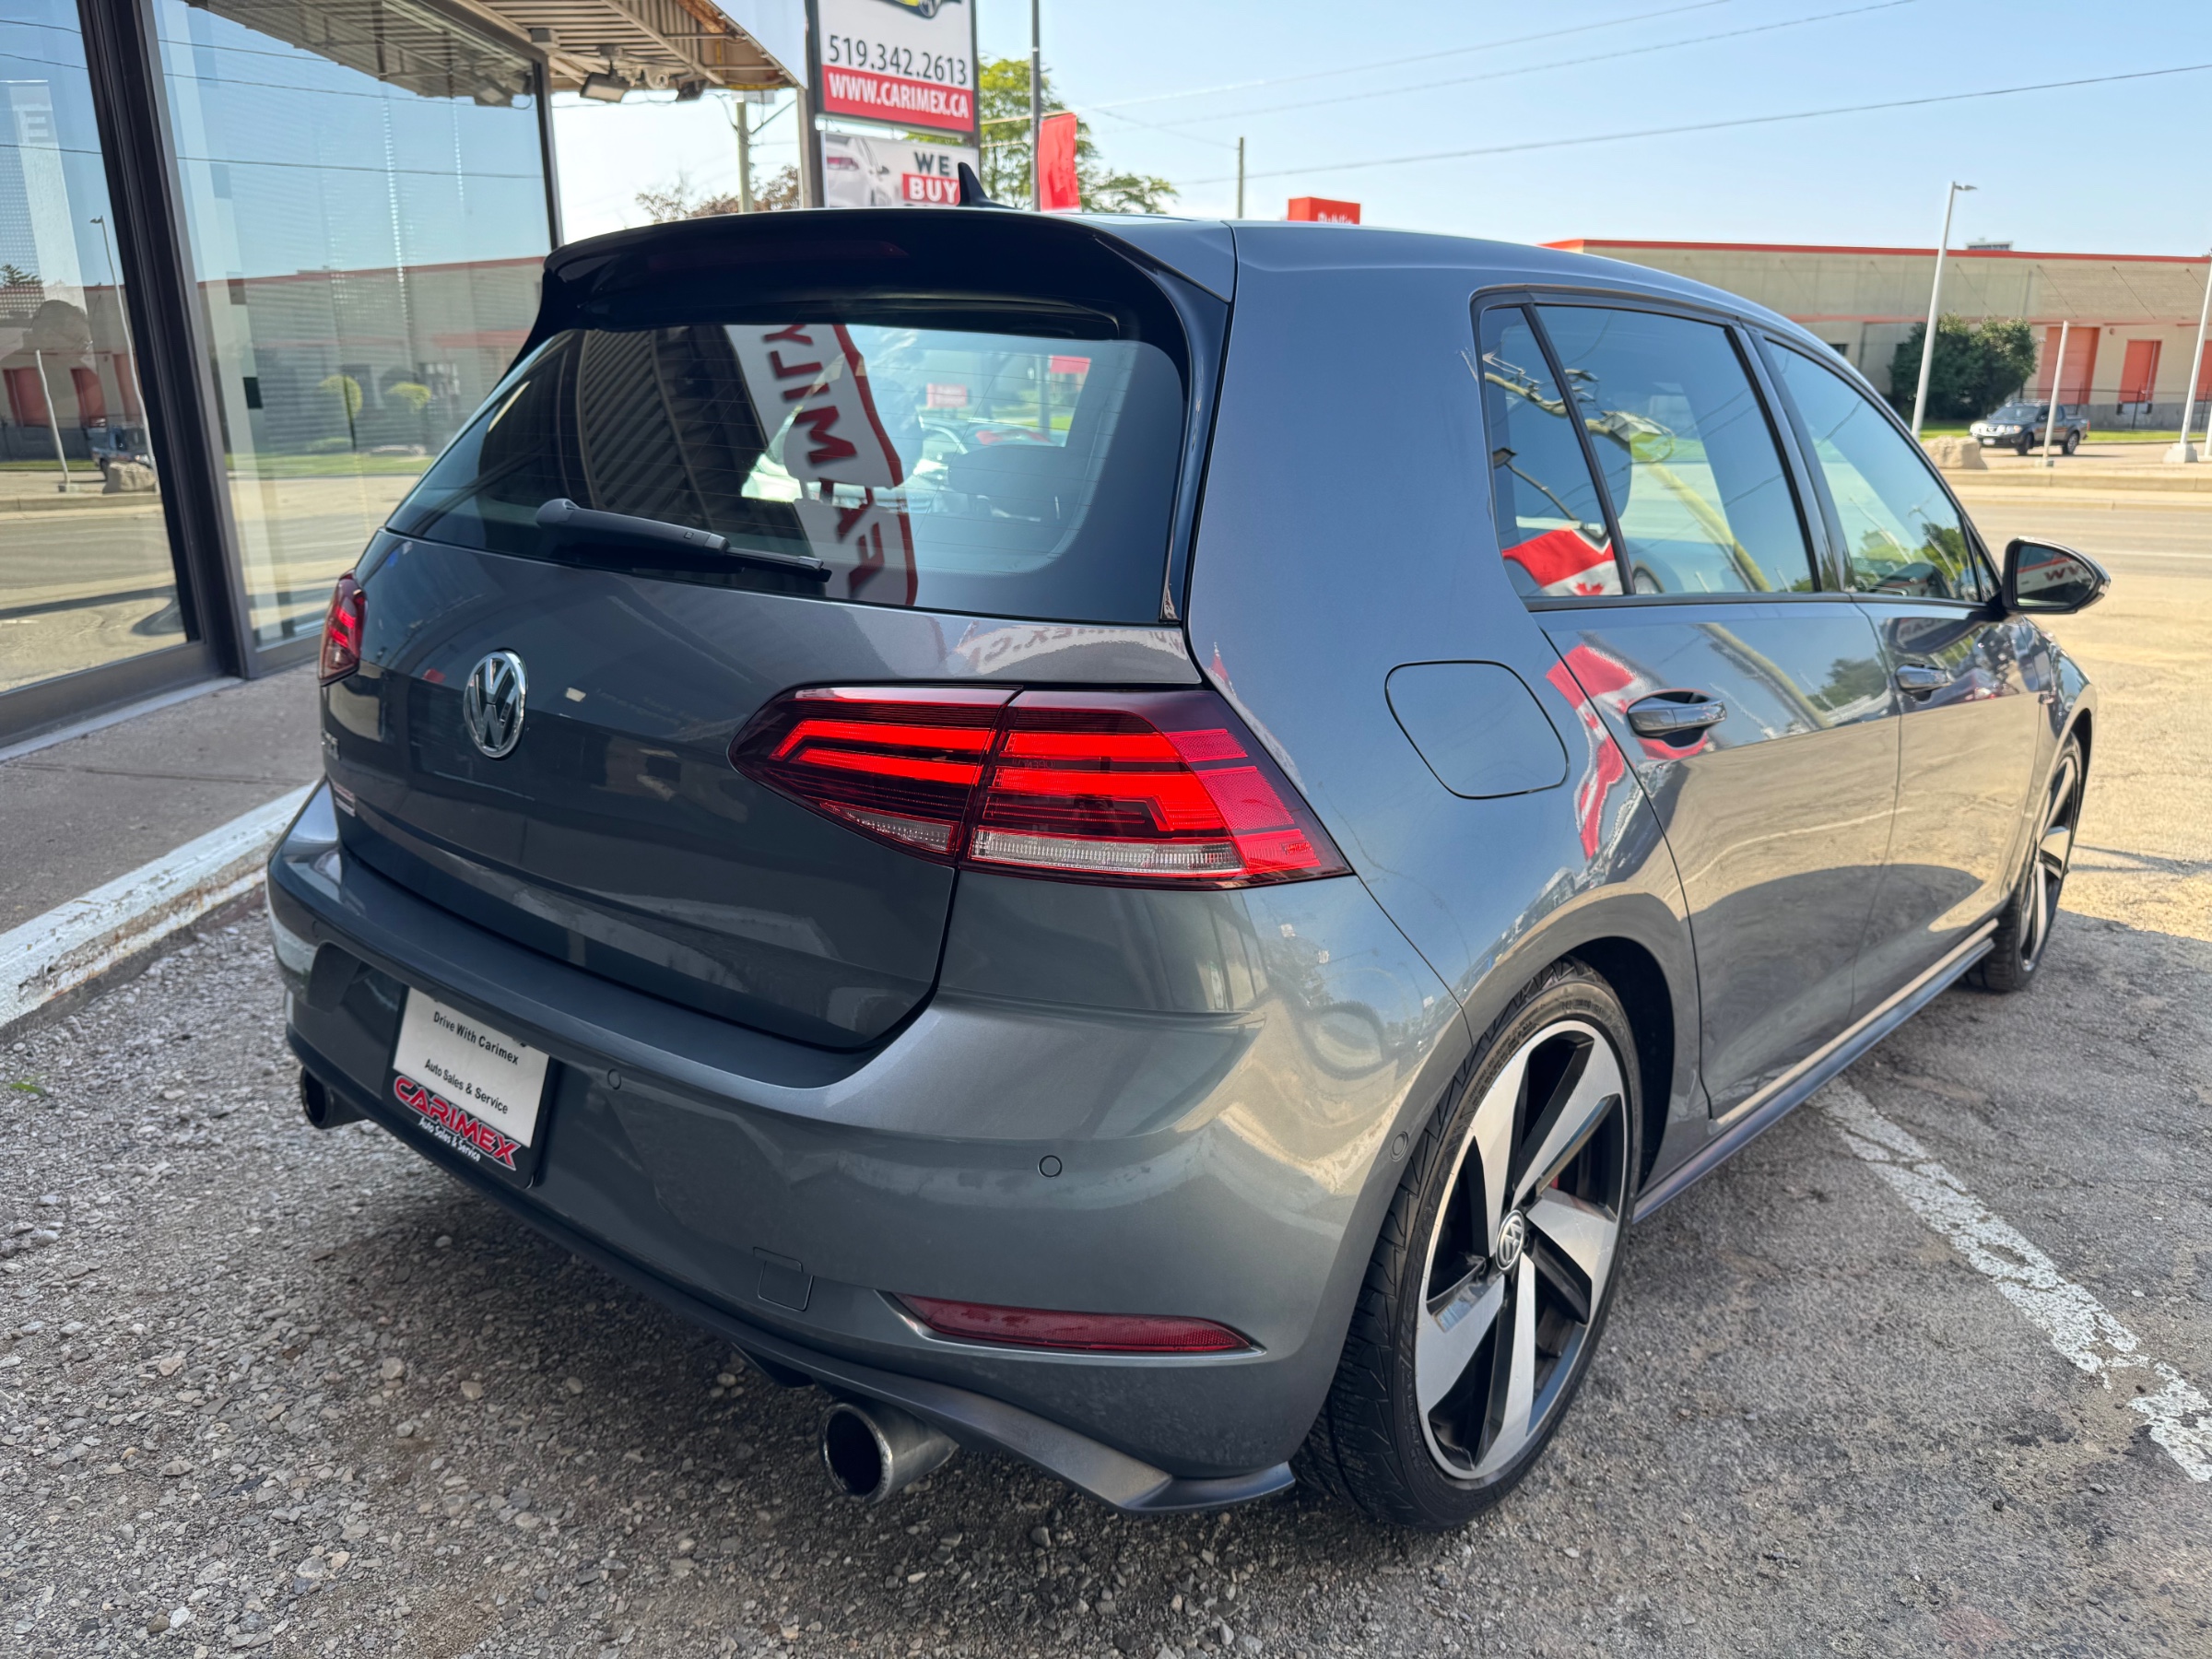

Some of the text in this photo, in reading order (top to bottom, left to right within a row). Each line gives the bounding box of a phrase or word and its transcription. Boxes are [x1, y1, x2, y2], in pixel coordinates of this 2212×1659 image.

[830, 35, 966, 86] 519.342.2613
[829, 73, 969, 119] WWW.CARIMEX.CA
[913, 151, 950, 177] WE
[909, 176, 959, 204] BUY
[464, 650, 527, 759] VW
[433, 1011, 519, 1065] Drive With Carimex
[425, 1058, 508, 1114] Auto Sales & Service
[394, 1076, 521, 1170] CARIMEX
[418, 1116, 434, 1133] Auto
[434, 1124, 452, 1144] Sales
[457, 1139, 481, 1162] Service
